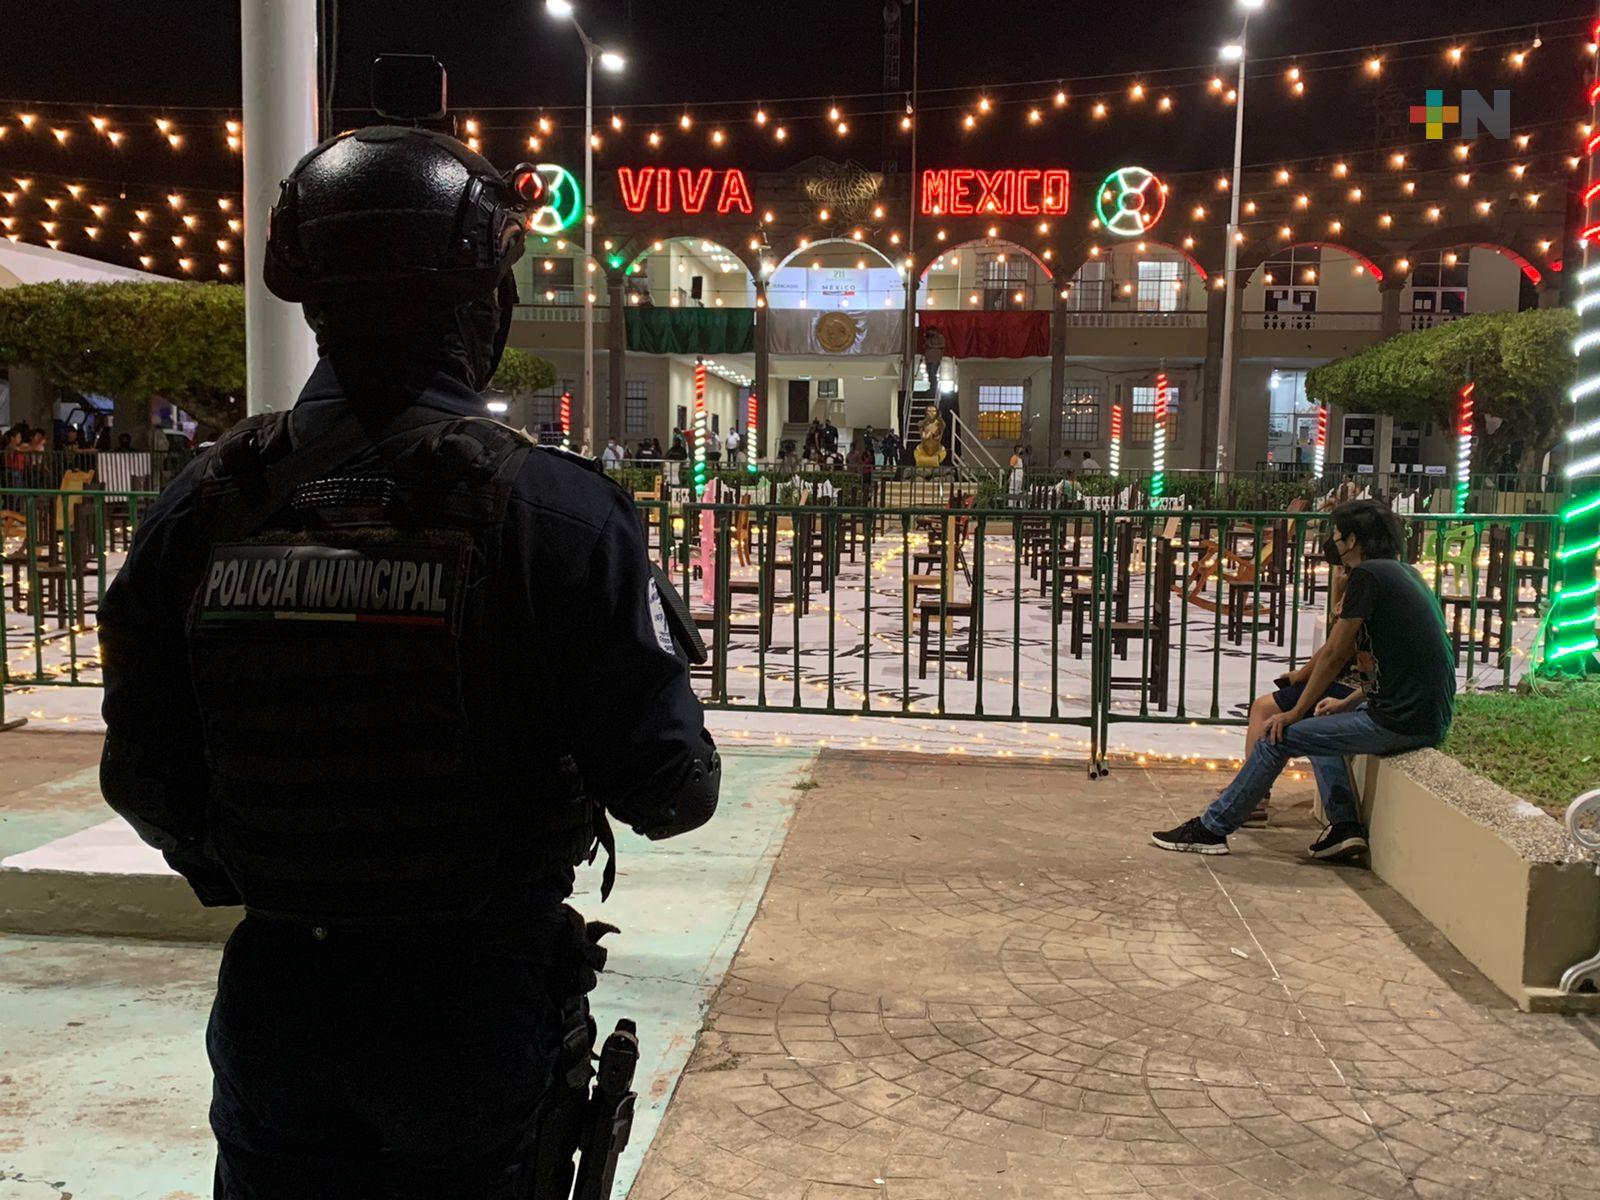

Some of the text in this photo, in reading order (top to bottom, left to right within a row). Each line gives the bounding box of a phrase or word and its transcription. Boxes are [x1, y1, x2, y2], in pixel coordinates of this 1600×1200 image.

[617, 167, 1070, 215] VIVA MEXICO
[204, 550, 447, 612] POLICÍA MUNICIPAL
